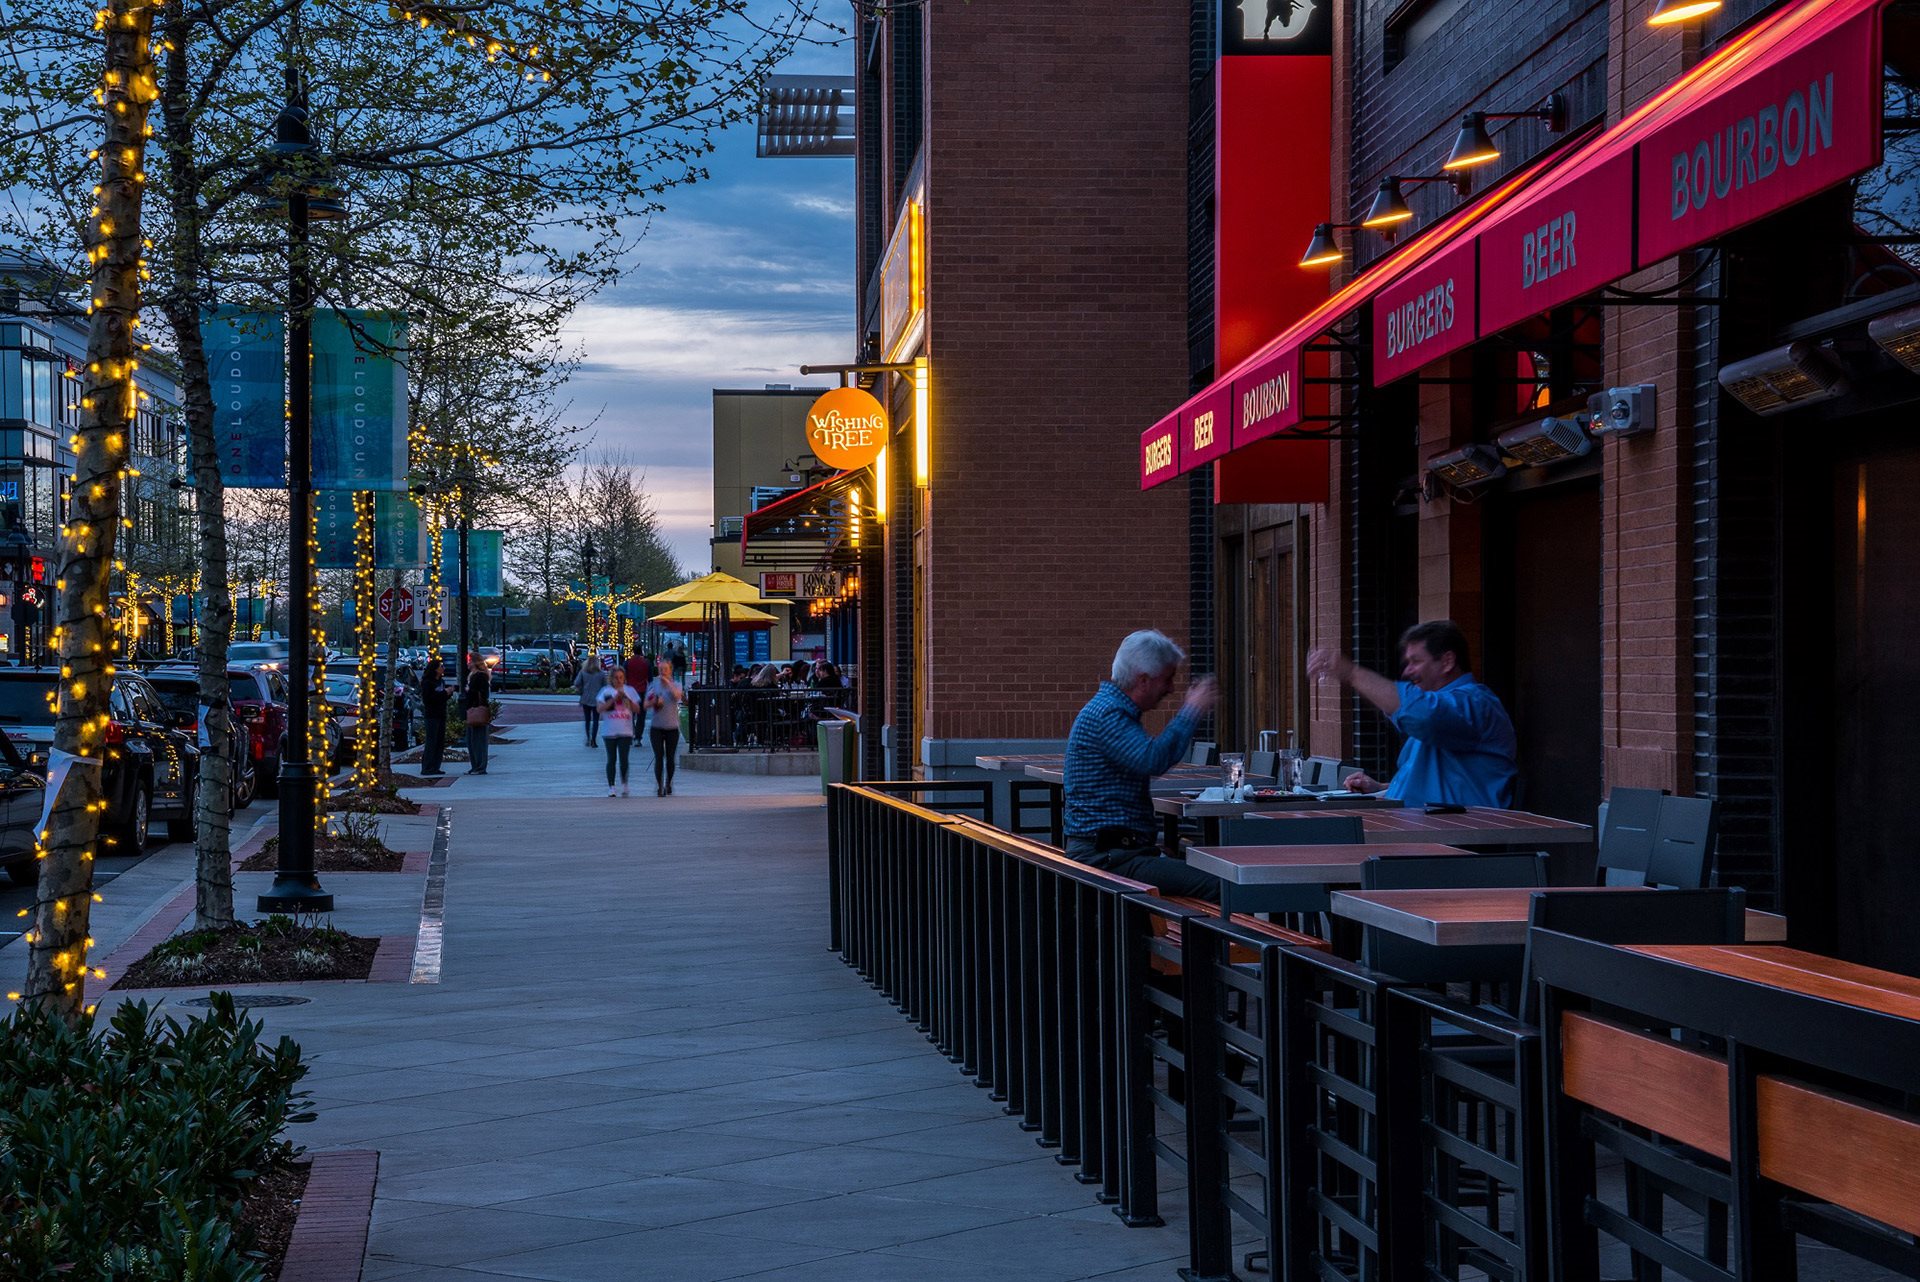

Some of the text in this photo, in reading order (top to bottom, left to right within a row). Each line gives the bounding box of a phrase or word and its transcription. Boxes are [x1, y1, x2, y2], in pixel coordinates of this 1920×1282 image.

[1671, 71, 1834, 222] BOURBON
[1522, 210, 1577, 290] BEER
[1387, 278, 1455, 359] BURGERS
[1243, 370, 1290, 430] BOURBON
[811, 409, 884, 433] WISHING
[813, 428, 873, 451] TREE
[1194, 410, 1214, 451] BEER
[1145, 433, 1172, 476] BURGERS
[416, 590, 447, 598] SPD
[802, 573, 837, 586] LONG &
[419, 599, 444, 607] LIT
